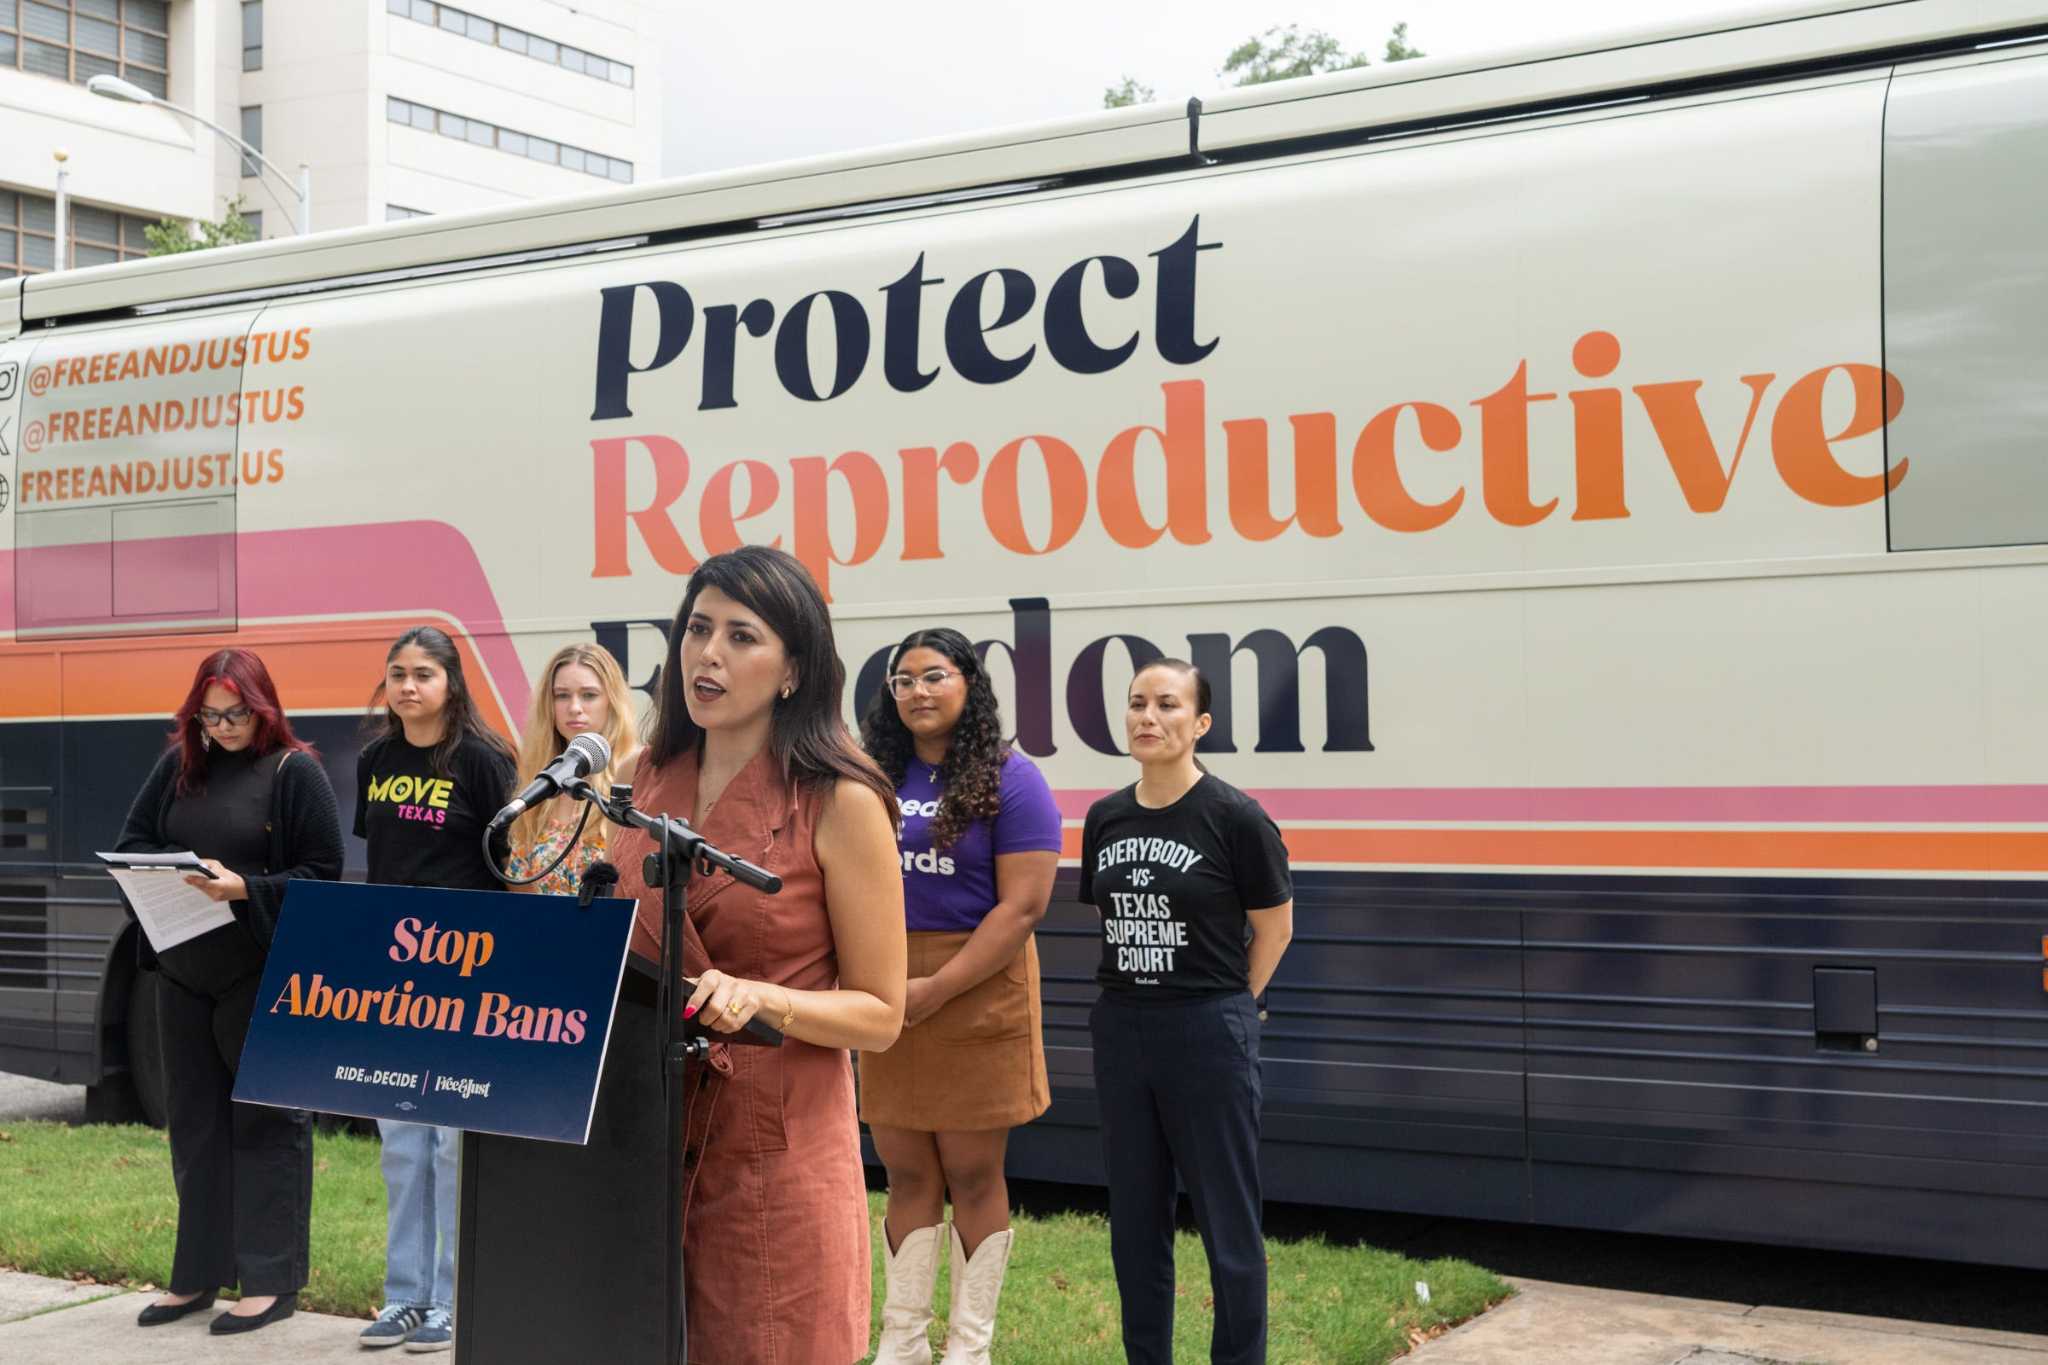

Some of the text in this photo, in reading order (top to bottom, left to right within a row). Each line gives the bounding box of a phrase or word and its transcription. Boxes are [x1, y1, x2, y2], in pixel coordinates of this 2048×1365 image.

[590, 213, 1223, 420] Protect
[28, 327, 311, 397] @FREEANDJUSTUS
[23, 385, 305, 452] @FREEANDJUSTUS
[20, 448, 285, 505] FREEANDJUST.US
[590, 330, 1910, 603] Reproductive
[368, 774, 454, 809] MOVE
[398, 804, 446, 824] TEXAS
[900, 847, 956, 876] rds
[1098, 837, 1203, 873] EVERYBODY
[1110, 892, 1171, 919] TEXAS
[388, 917, 495, 977] Stop
[1105, 919, 1189, 946] SUPREME
[1117, 946, 1175, 973] COURT
[270, 973, 588, 1045] Abortion Bans
[335, 1065, 365, 1082] RIDE
[372, 1070, 418, 1089] DECIDE
